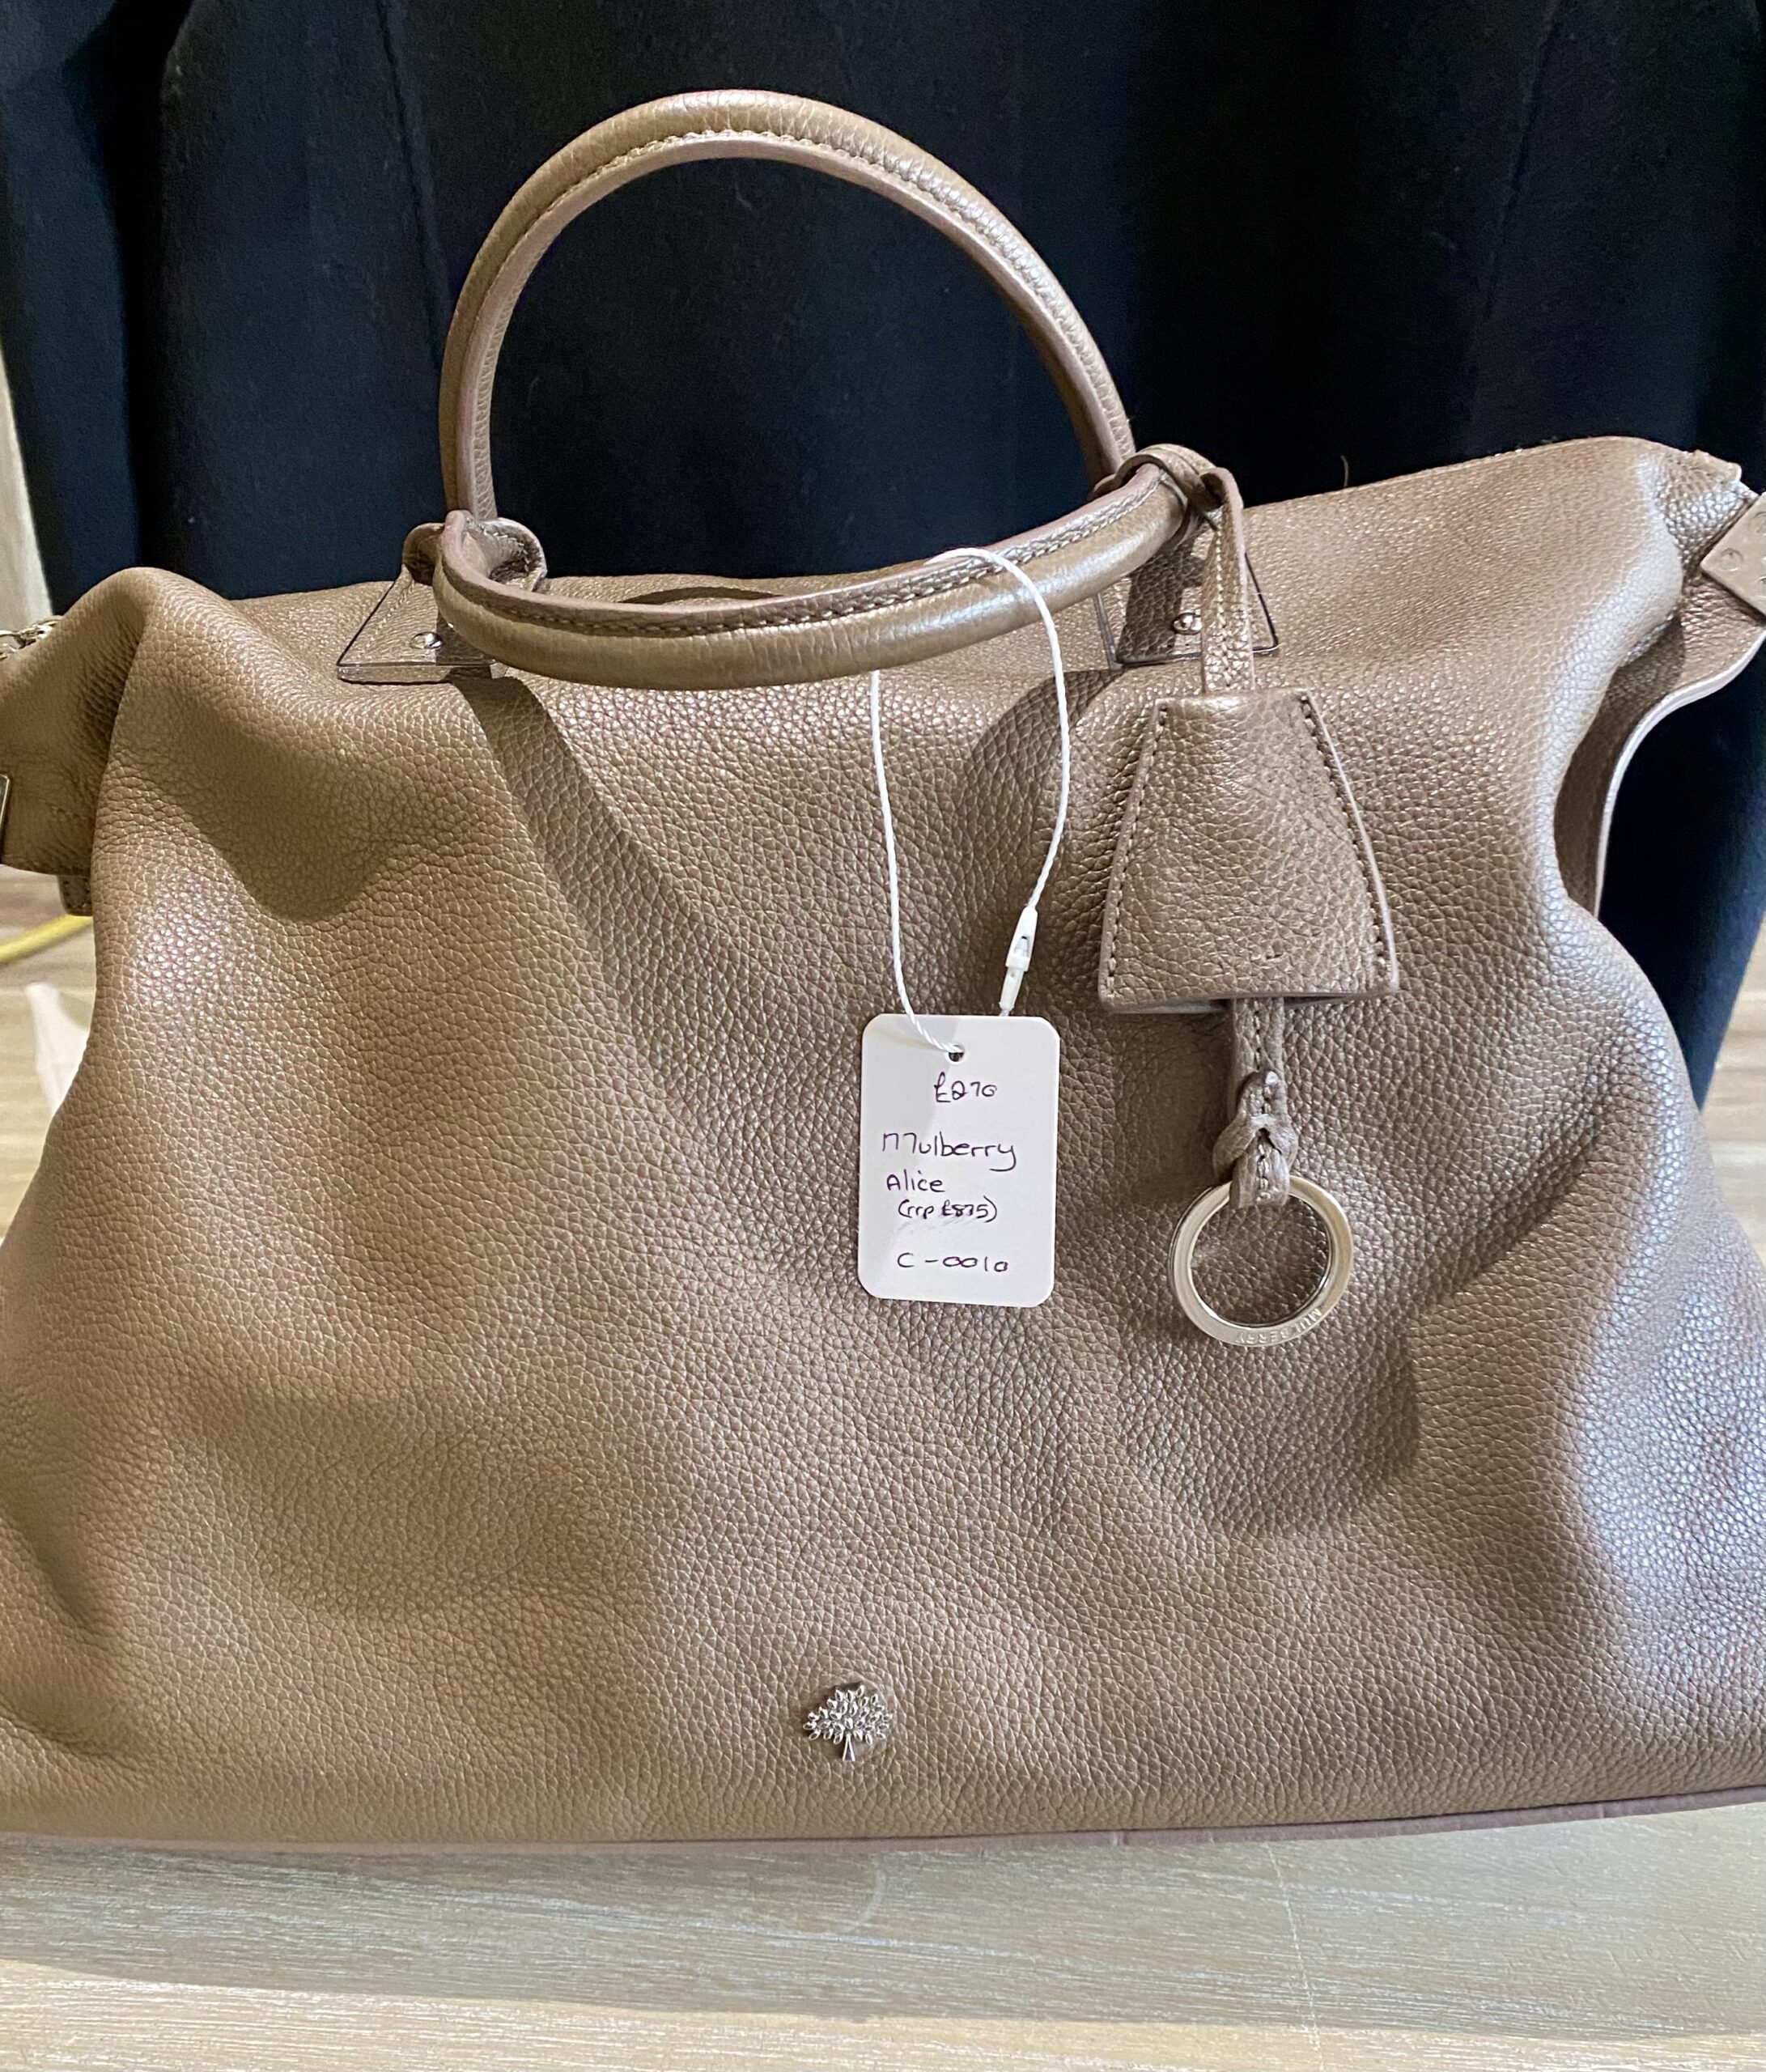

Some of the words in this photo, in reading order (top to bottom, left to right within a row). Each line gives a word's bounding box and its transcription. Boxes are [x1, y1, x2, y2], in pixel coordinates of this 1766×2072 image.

[881, 1131, 1017, 1173] Mulberry
[885, 1169, 947, 1193] Alice
[898, 1198, 935, 1220] (rrp
